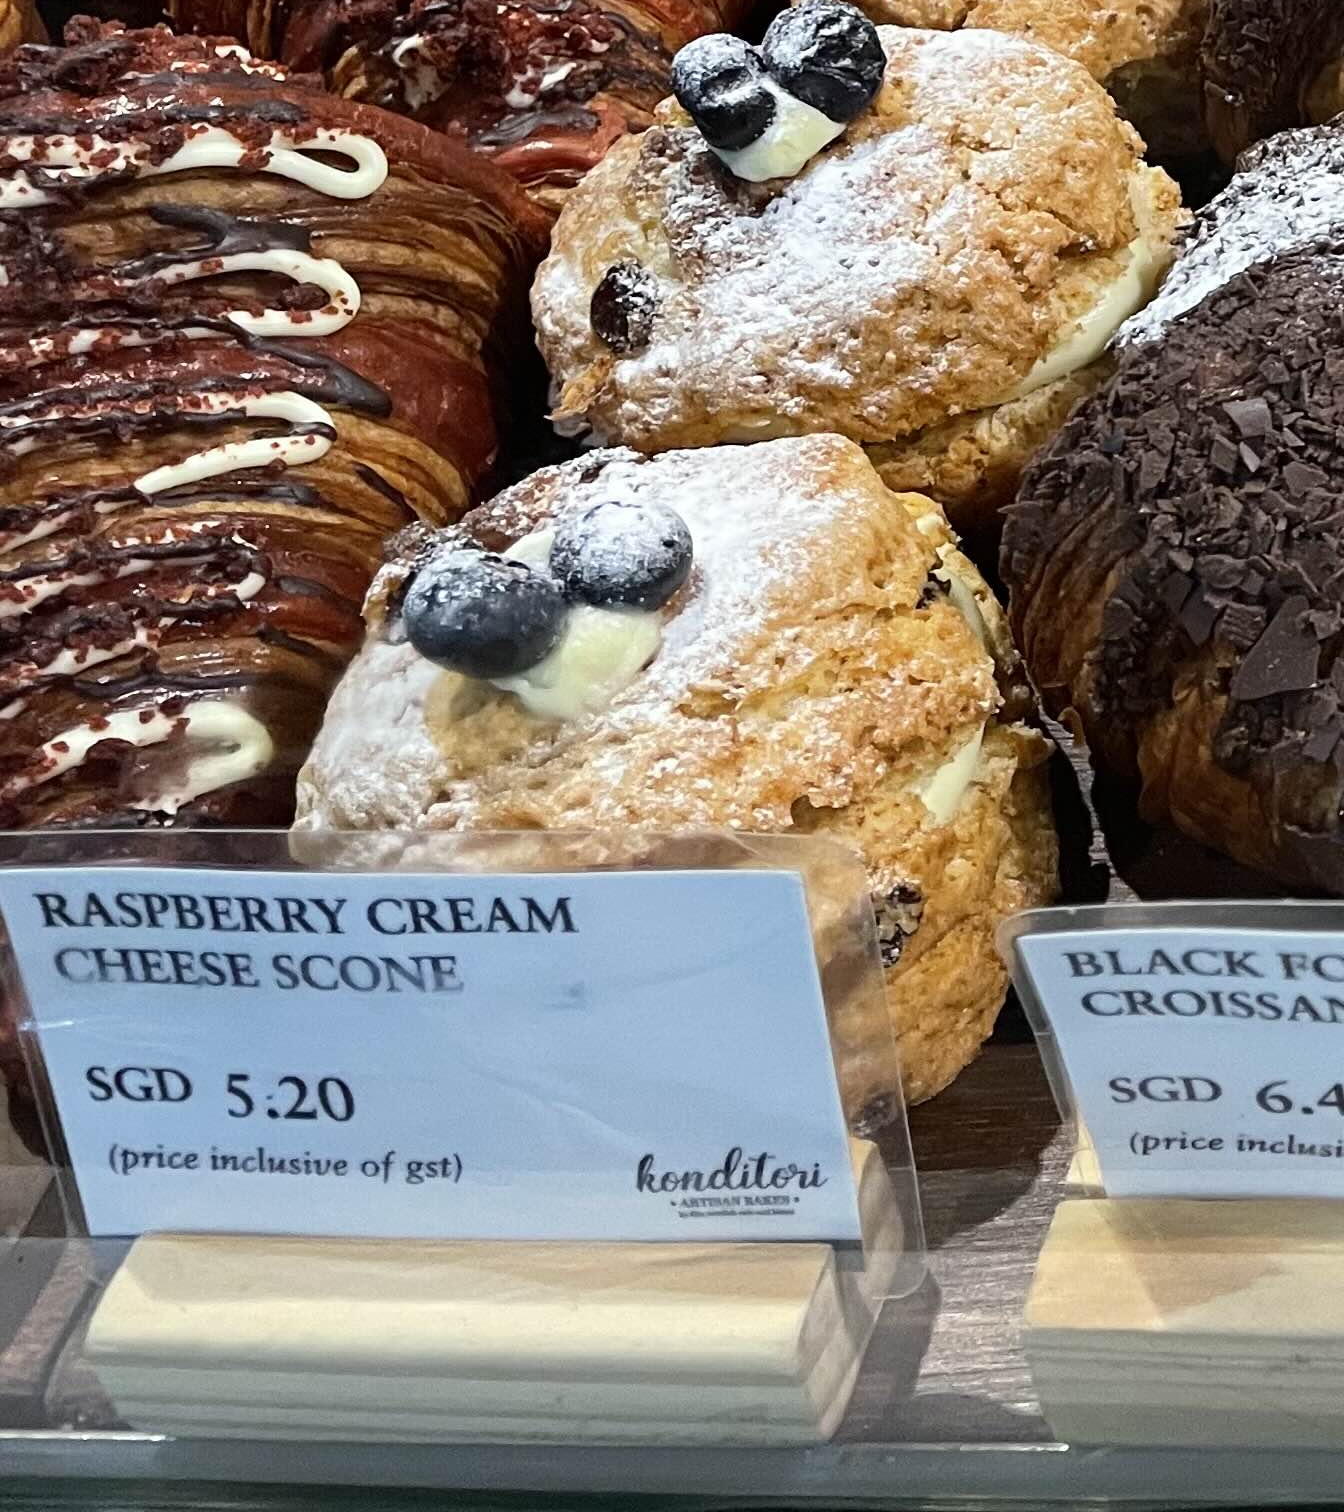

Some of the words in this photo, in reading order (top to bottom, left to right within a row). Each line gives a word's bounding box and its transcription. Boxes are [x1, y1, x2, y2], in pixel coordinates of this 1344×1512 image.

[34, 893, 348, 934] RASPBERRY
[367, 896, 579, 934] CREAM
[54, 946, 261, 987] CHEESE
[273, 955, 465, 993] SCONE
[1063, 949, 1264, 980] BLACK
[85, 1066, 193, 1102] SGD
[226, 1074, 355, 1122] 5.20
[1108, 1076, 1223, 1104] SGD
[1127, 1130, 1226, 1155] (price
[107, 1144, 200, 1174] (price
[210, 1145, 350, 1177] inclusive
[361, 1147, 401, 1180] of
[404, 1152, 463, 1184] gst)
[635, 1146, 830, 1193] konditori
